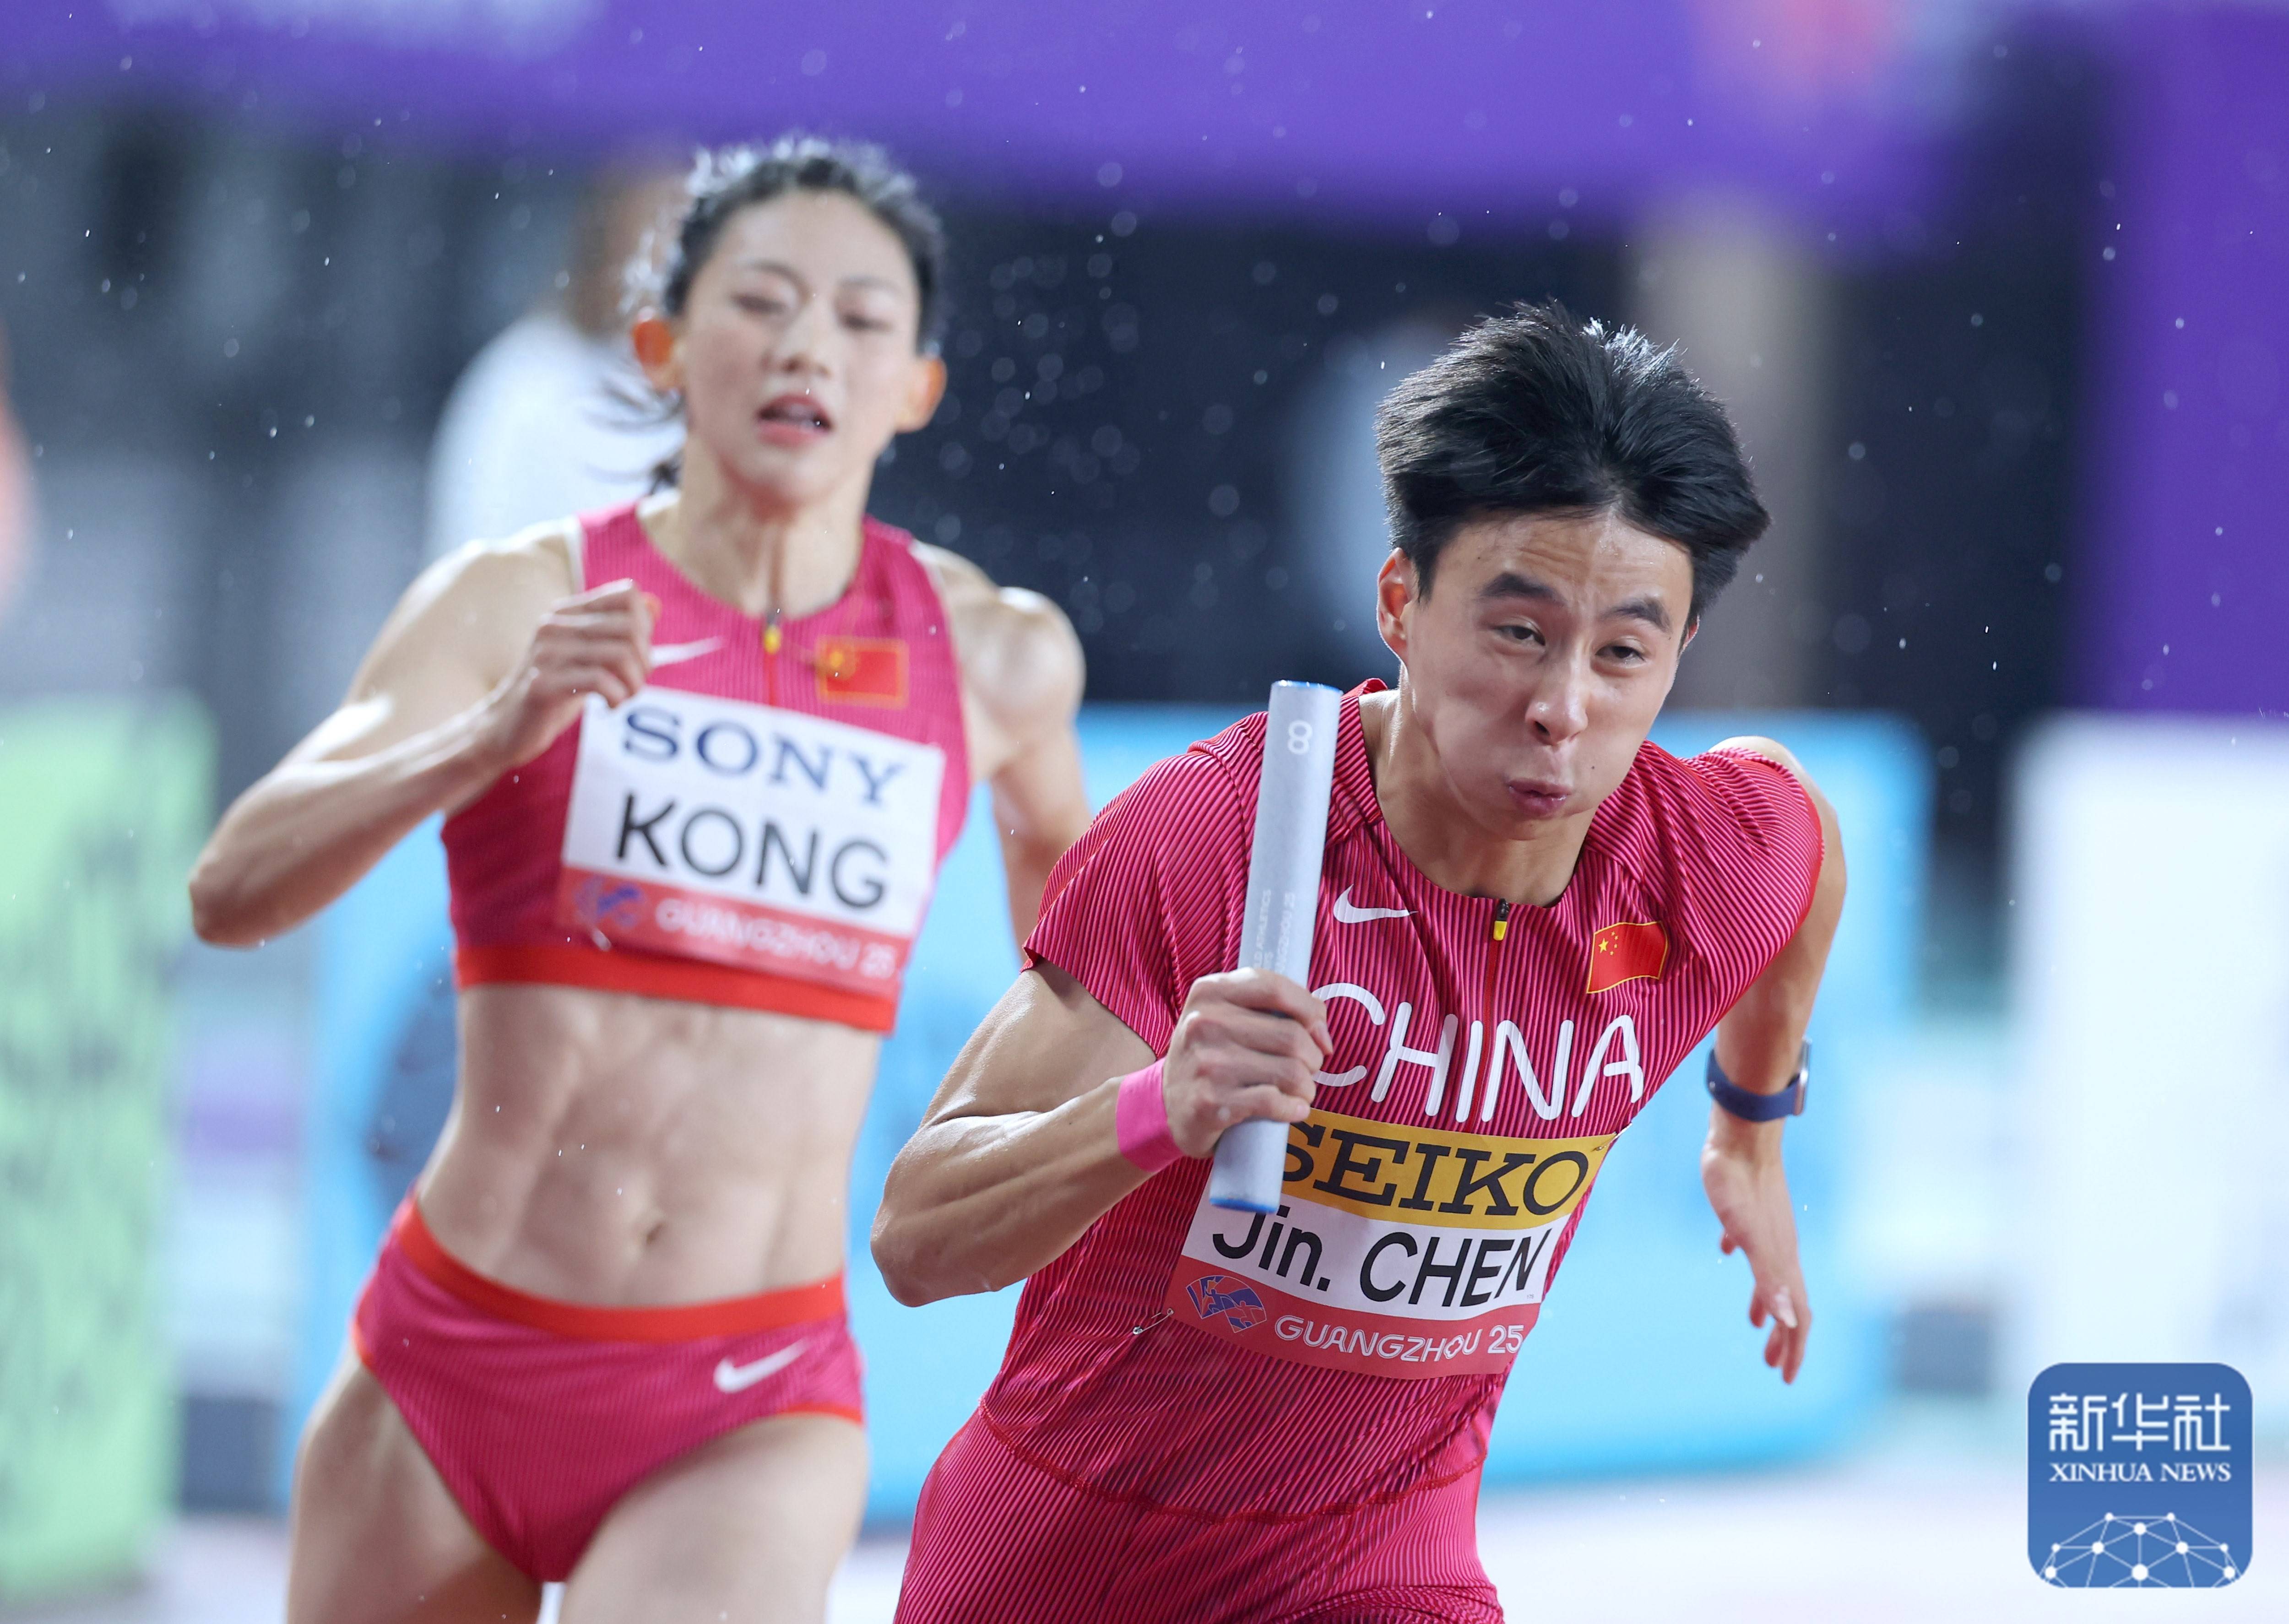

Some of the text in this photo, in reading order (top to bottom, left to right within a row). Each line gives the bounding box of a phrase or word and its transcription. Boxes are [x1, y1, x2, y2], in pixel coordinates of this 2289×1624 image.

[623, 705, 905, 804] SONY
[1288, 720, 1313, 754] 8
[617, 790, 888, 909] KONG
[656, 899, 860, 969] GUANGZHOU
[1311, 983, 1644, 1122] CHINA
[1213, 1207, 1552, 1307] Jin. CHEN
[1275, 1315, 1524, 1363] GUANGZHOU 25
